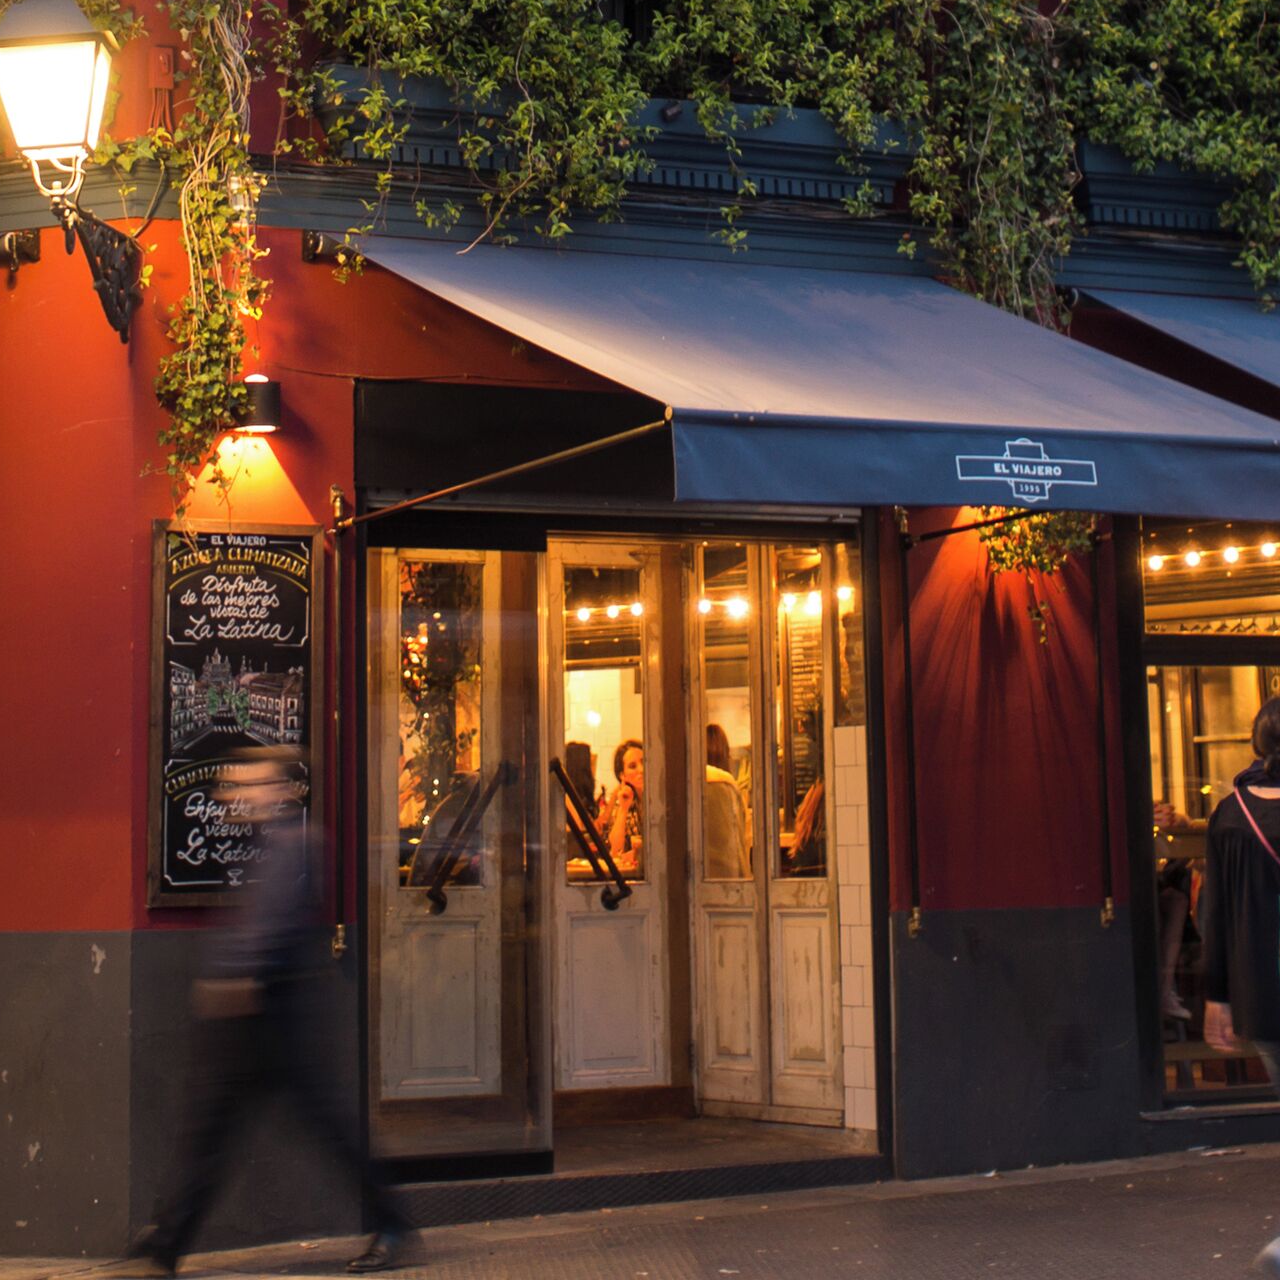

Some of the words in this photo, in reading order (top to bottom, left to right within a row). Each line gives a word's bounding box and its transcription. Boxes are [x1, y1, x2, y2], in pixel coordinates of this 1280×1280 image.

[994, 463, 1009, 474] EL
[1012, 464, 1062, 476] VIAJERO
[211, 535, 223, 545] EL
[226, 535, 267, 546] VIAJERO
[215, 564, 257, 575] ABIERTA
[228, 547, 307, 579] CLIMATIZADA
[202, 575, 277, 596] Disfruta
[180, 589, 198, 605] de
[201, 592, 221, 605] las
[223, 592, 280, 608] mejores
[209, 605, 248, 618] vistas
[248, 604, 270, 619] de
[184, 614, 215, 640] La
[218, 617, 295, 640] Latina
[184, 792, 227, 825] Enjoy
[205, 821, 254, 838] views
[176, 827, 209, 866] La
